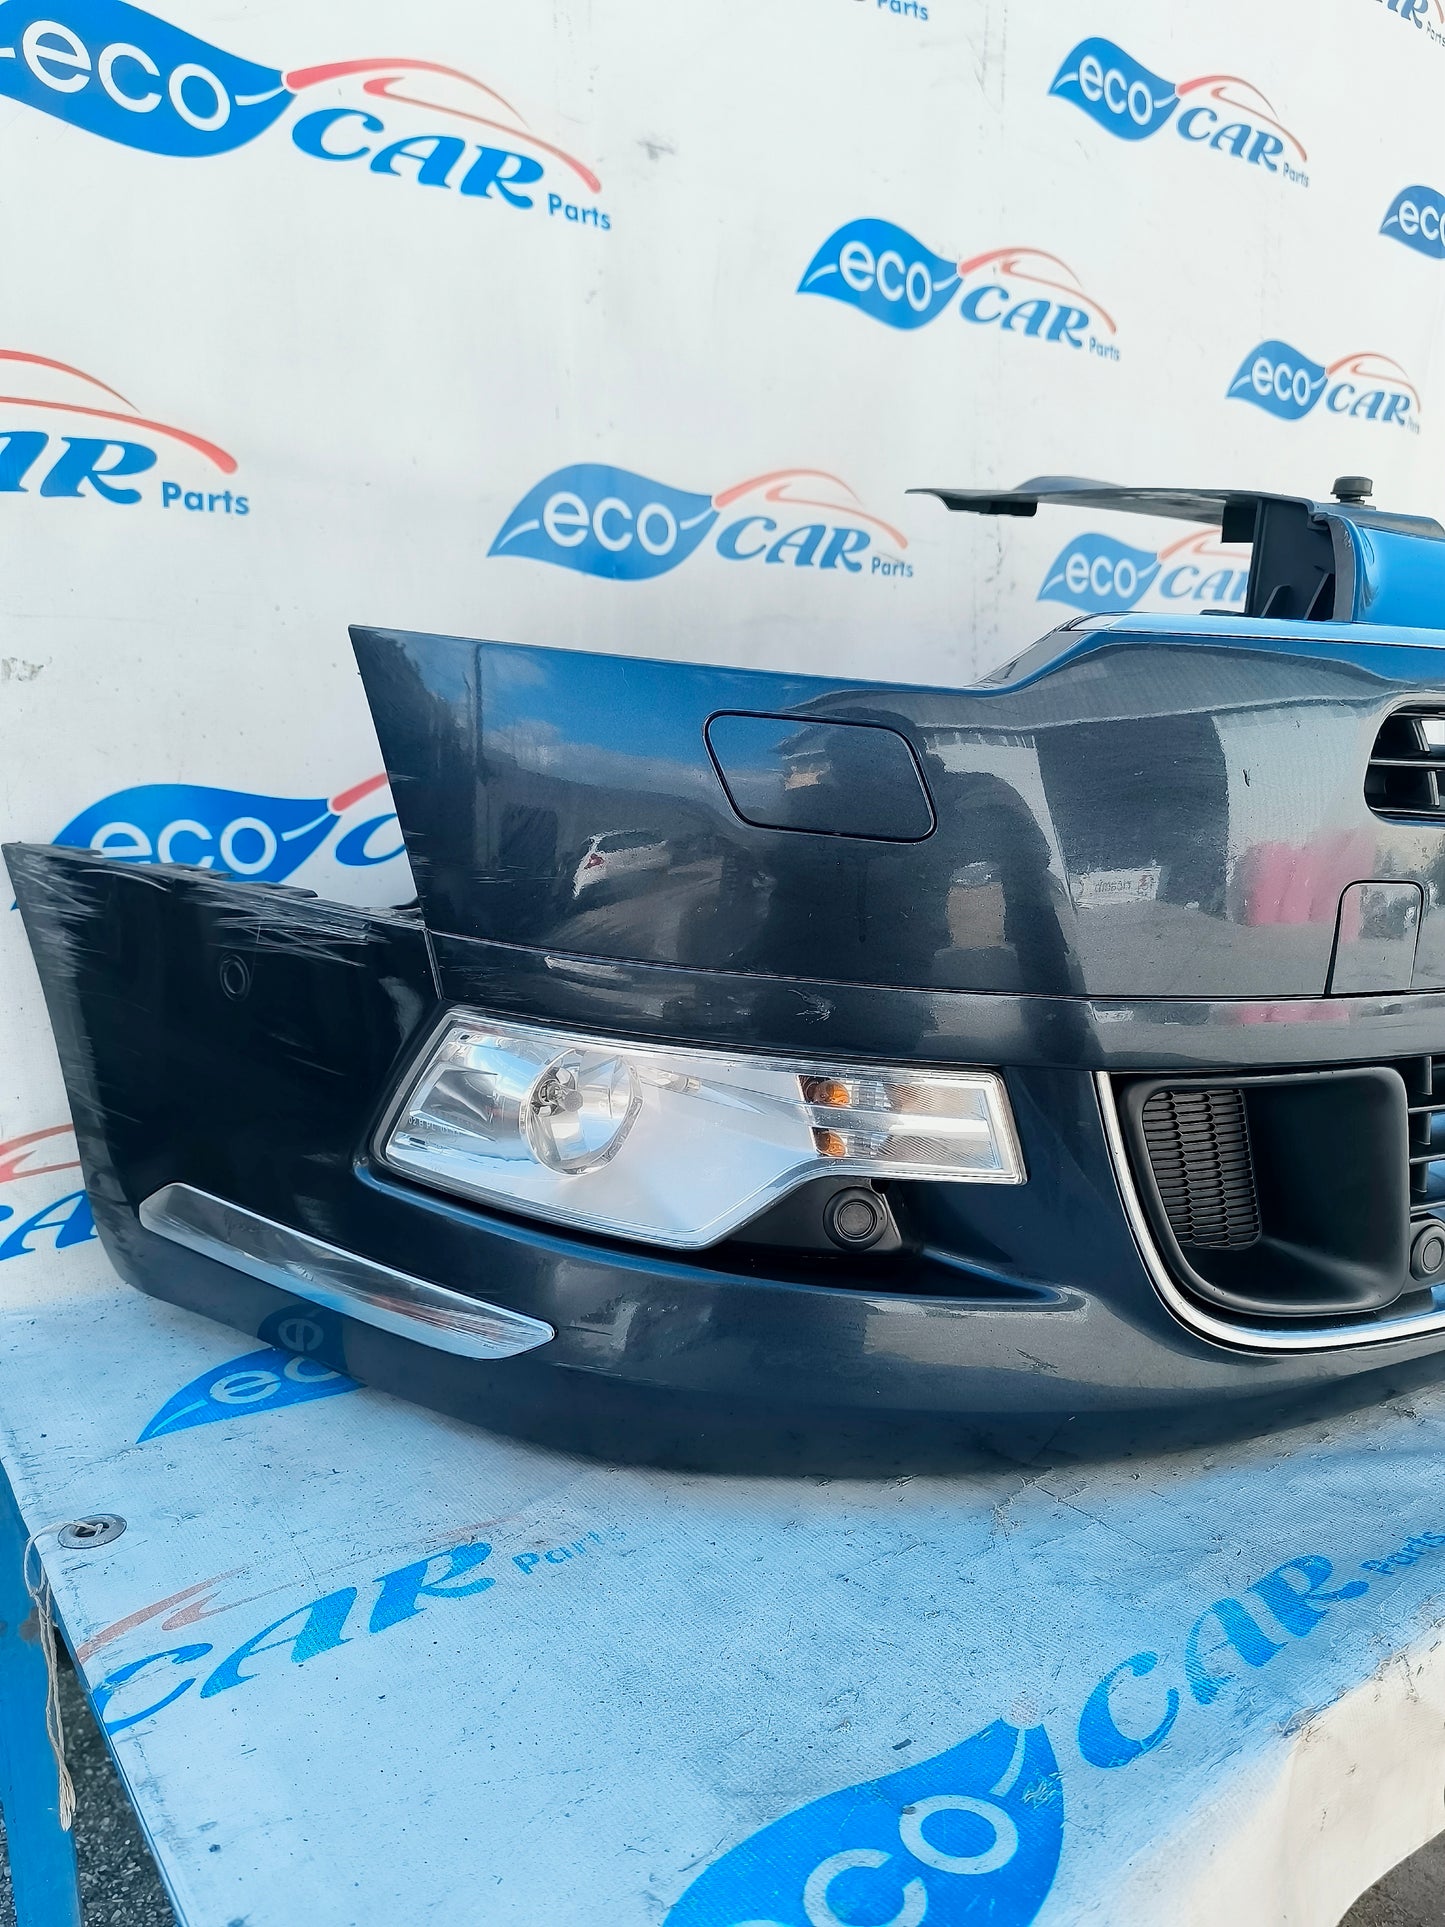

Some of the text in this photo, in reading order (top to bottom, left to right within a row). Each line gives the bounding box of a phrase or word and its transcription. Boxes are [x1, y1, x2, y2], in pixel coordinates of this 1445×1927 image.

[22, 20, 612, 231] eco CAR Parts
[1078, 54, 1310, 188] eco CAR Parts
[839, 240, 1121, 362] eco CAR Parts
[1251, 357, 1312, 407] eco
[1326, 383, 1410, 426] CAR
[162, 481, 250, 515] Parts
[543, 491, 914, 578] eco CAR Parts
[1065, 552, 1138, 599] eco
[89, 816, 278, 875] eco
[93, 1541, 497, 1736] CAR
[730, 1793, 1019, 1927] co
[1078, 1553, 1370, 1769] CAR
